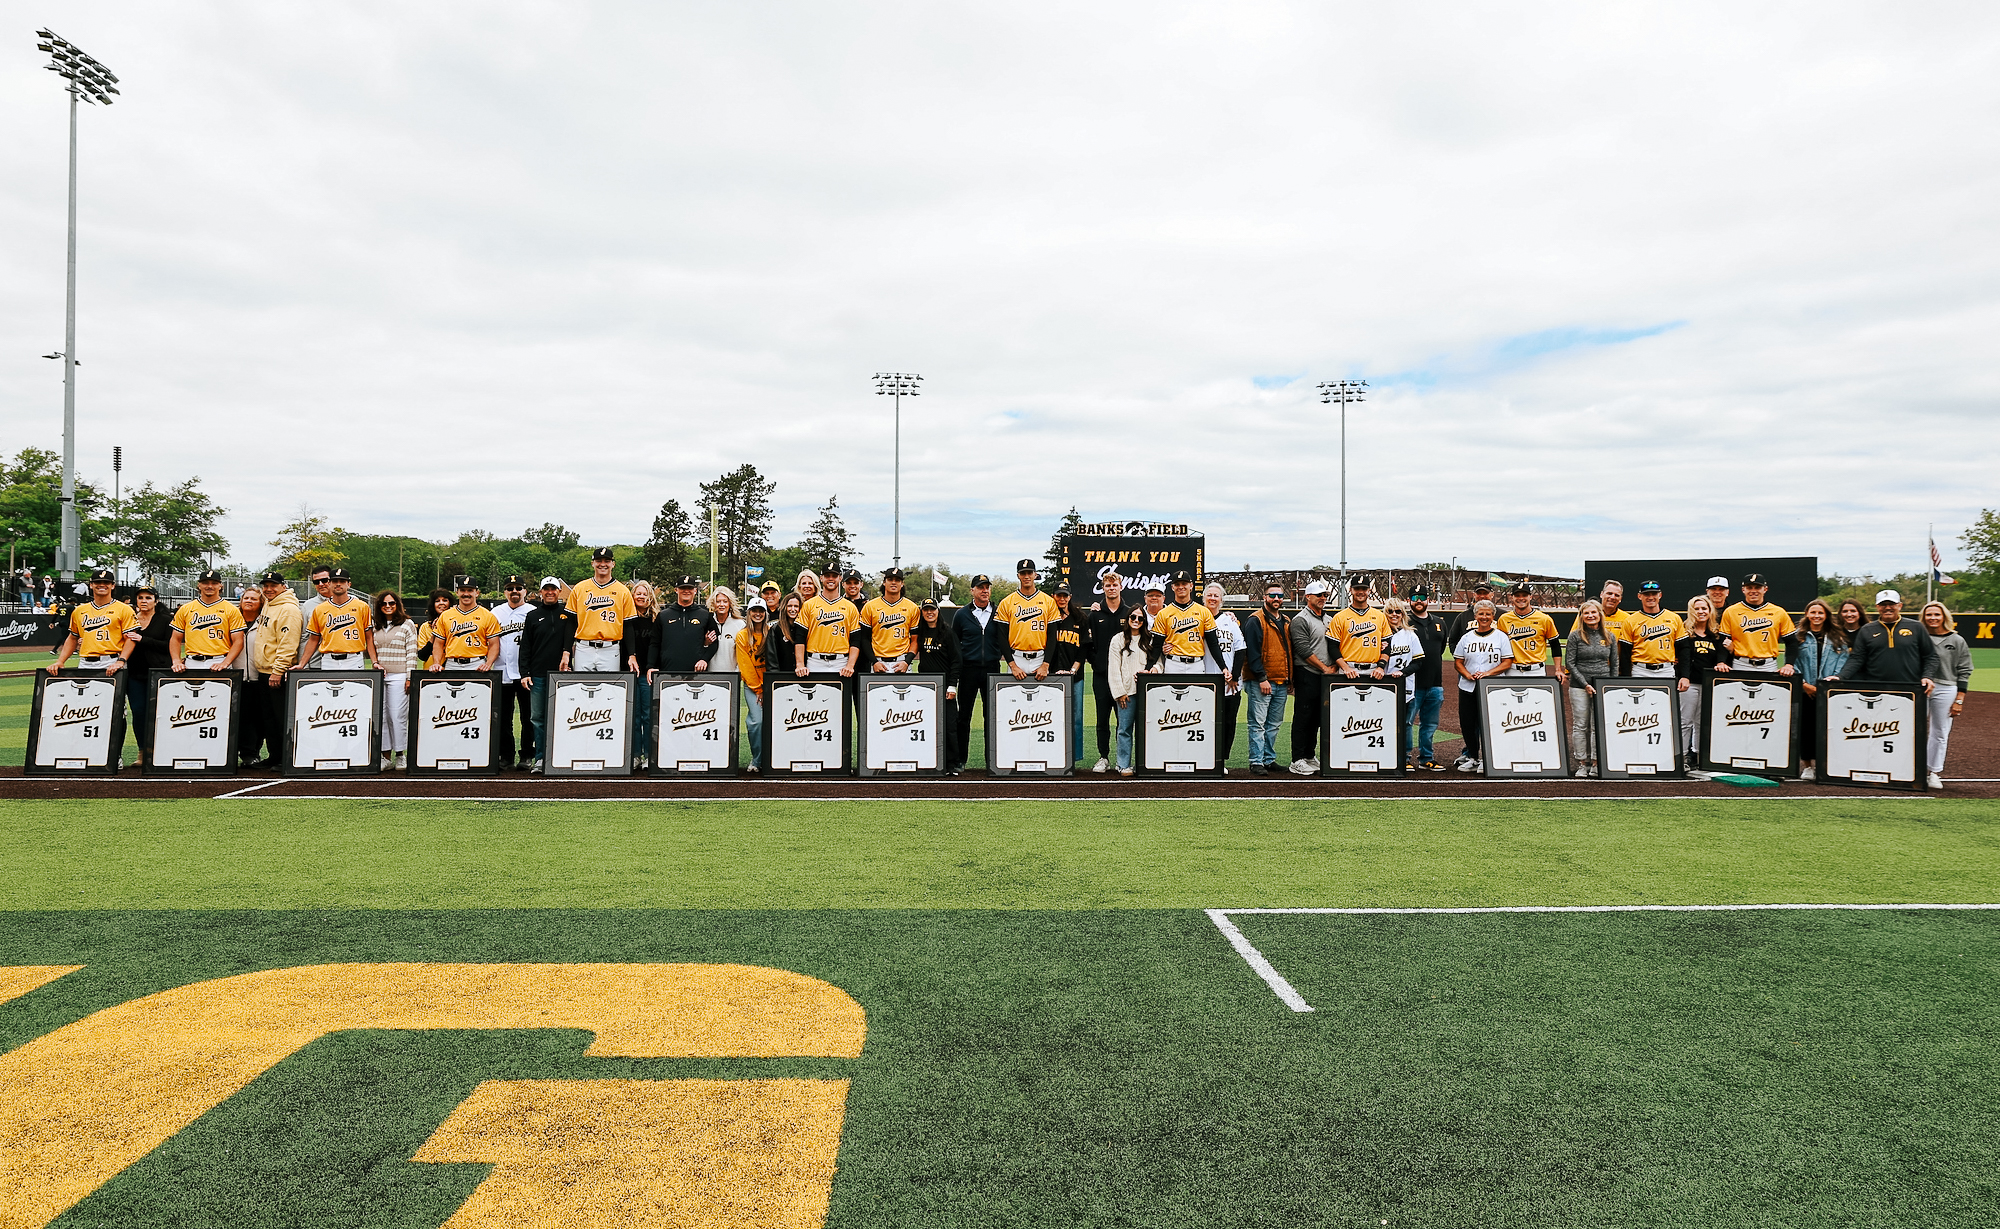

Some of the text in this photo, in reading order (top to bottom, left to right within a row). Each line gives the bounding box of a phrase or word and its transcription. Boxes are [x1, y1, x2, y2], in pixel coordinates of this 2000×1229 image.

[1077, 524, 1188, 535] BANKS FIELD
[1084, 551, 1180, 562] THANK YOU
[1093, 564, 1172, 595] Sniors
[585, 592, 610, 605] Iowa
[601, 610, 615, 622] 42
[816, 609, 840, 620] Iowa
[1015, 606, 1038, 617] Iowa
[82, 614, 107, 628] Iowa
[190, 613, 216, 625] Iowa
[326, 614, 350, 627] Iowa
[878, 612, 901, 624] Iowa
[1171, 617, 1194, 630] Iowa
[1741, 616, 1767, 628] Iowa
[450, 620, 473, 633] Iowa
[832, 625, 846, 637] 34
[1032, 620, 1044, 631] 26
[1348, 620, 1372, 634] Iowa
[1508, 624, 1532, 635] Iowa
[1640, 624, 1665, 637] Iowa
[1976, 622, 1996, 638] K
[96, 630, 110, 640] 51
[209, 629, 223, 639] 50
[344, 629, 359, 640] 49
[894, 628, 905, 638] 31
[1762, 632, 1769, 642] 7
[466, 635, 481, 646] 43
[1362, 636, 1377, 647] 24
[1524, 640, 1536, 650] 19
[1659, 639, 1670, 650] 17
[1220, 643, 1232, 652] 25
[1467, 642, 1494, 653] IOWA
[1488, 654, 1498, 663] 19
[54, 704, 100, 721] Iowa
[170, 704, 216, 722] Iowa
[308, 706, 358, 722] Iowa
[432, 706, 478, 722] Iowa
[568, 707, 612, 724] Iowa
[672, 707, 716, 724] Iowa
[785, 708, 828, 725] Iowa
[880, 708, 923, 725] Iowa
[1009, 708, 1052, 726] Iowa
[1158, 708, 1201, 726] Iowa
[1725, 705, 1775, 721] Iowa
[1341, 716, 1383, 733] Iowa
[1502, 711, 1543, 728] Iowa
[1616, 712, 1659, 728] Iowa
[1843, 717, 1900, 734] Iowa
[84, 726, 99, 738] 51
[200, 727, 218, 738] 50
[338, 725, 358, 737] 49
[460, 727, 480, 739] 43
[596, 729, 614, 740] 42
[703, 729, 718, 741] 41
[814, 730, 832, 742] 34
[910, 730, 925, 742] 31
[1038, 730, 1054, 742] 26
[1187, 730, 1204, 742] 25
[1531, 730, 1546, 742] 19
[1760, 728, 1770, 739] 7
[1368, 736, 1385, 748] 24
[1647, 733, 1661, 745] 17
[1883, 741, 1893, 753] 5
